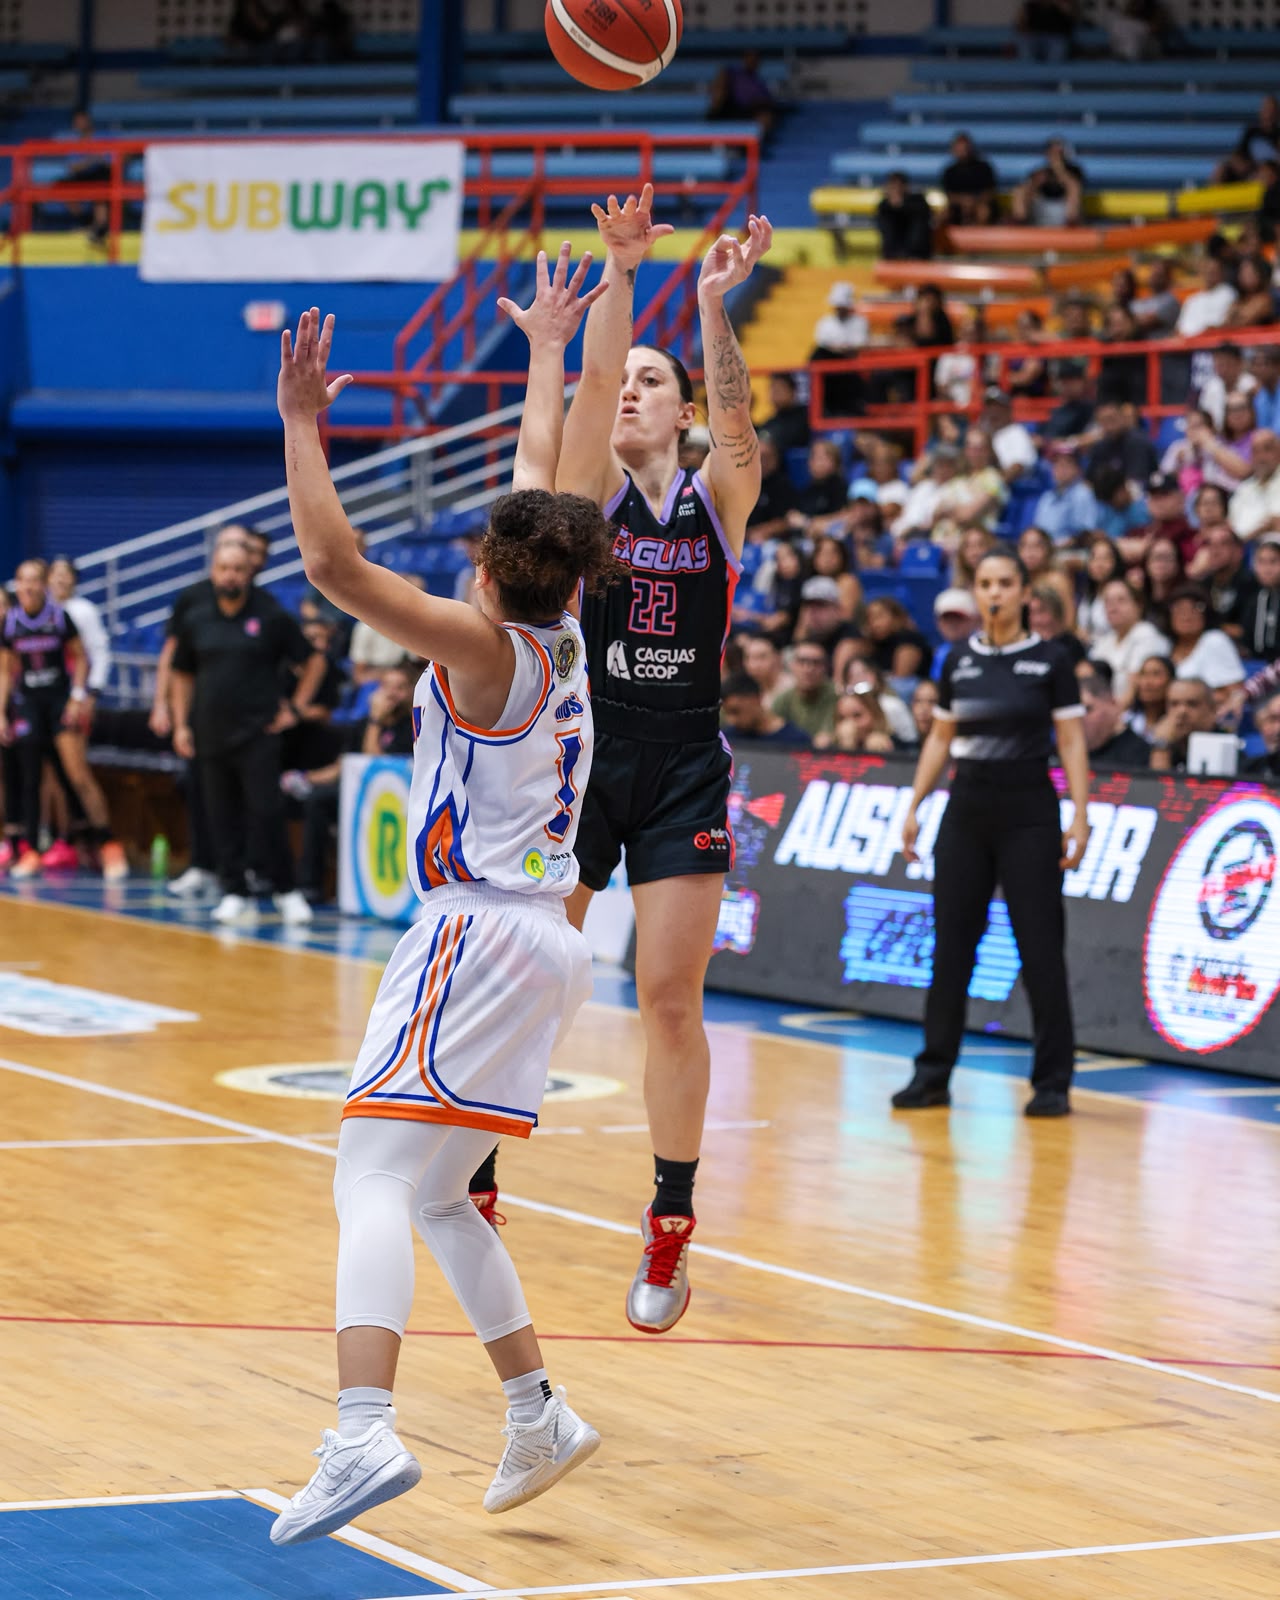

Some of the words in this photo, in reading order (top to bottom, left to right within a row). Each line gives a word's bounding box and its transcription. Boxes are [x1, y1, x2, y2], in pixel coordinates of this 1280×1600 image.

[156, 179, 451, 234] SUBWAY
[628, 577, 677, 636] 22
[633, 663, 679, 680] COOP
[635, 647, 696, 664] CAGUAS
[378, 811, 401, 883] R
